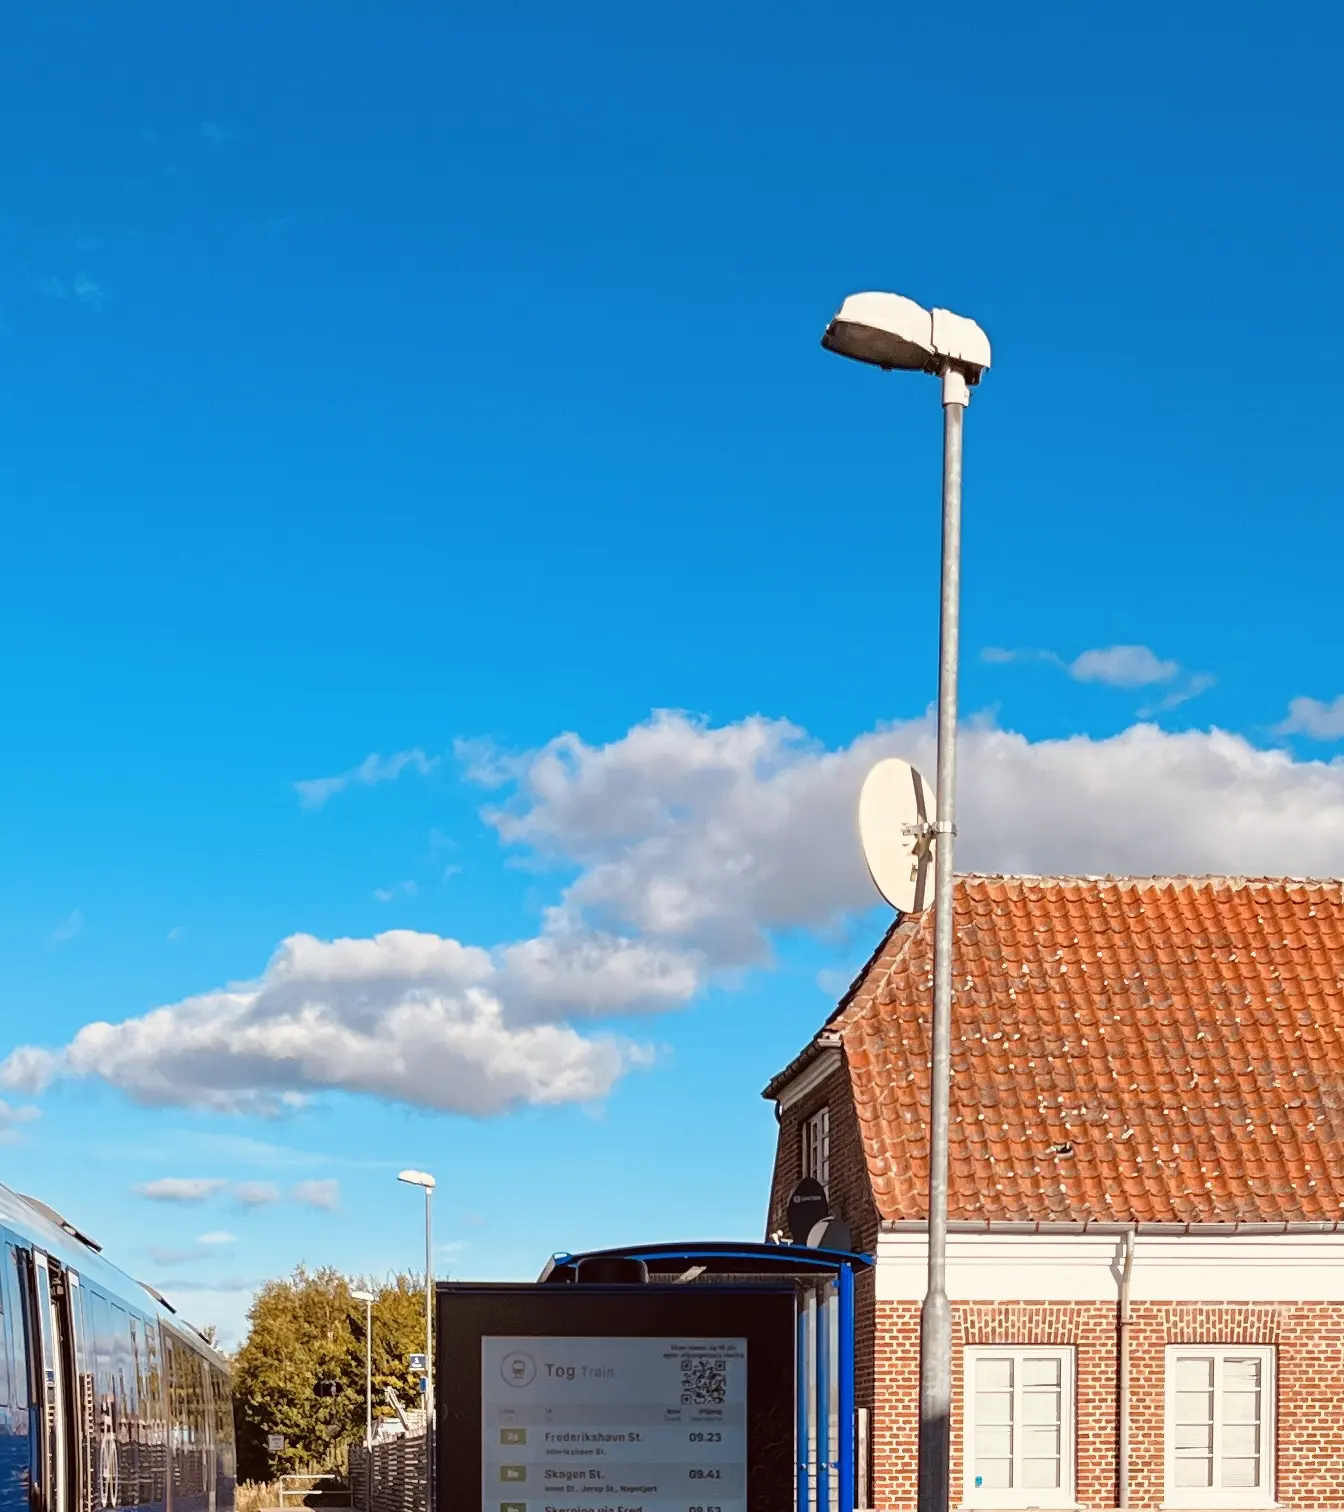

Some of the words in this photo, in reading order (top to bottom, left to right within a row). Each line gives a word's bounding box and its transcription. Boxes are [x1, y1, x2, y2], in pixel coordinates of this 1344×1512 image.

[545, 1364, 576, 1381] Tog
[581, 1365, 616, 1379] Train
[544, 1432, 626, 1443] Frederikshavn
[688, 1432, 722, 1443] 09.23
[544, 1469, 586, 1481] Skagen
[688, 1469, 722, 1480] 09.41
